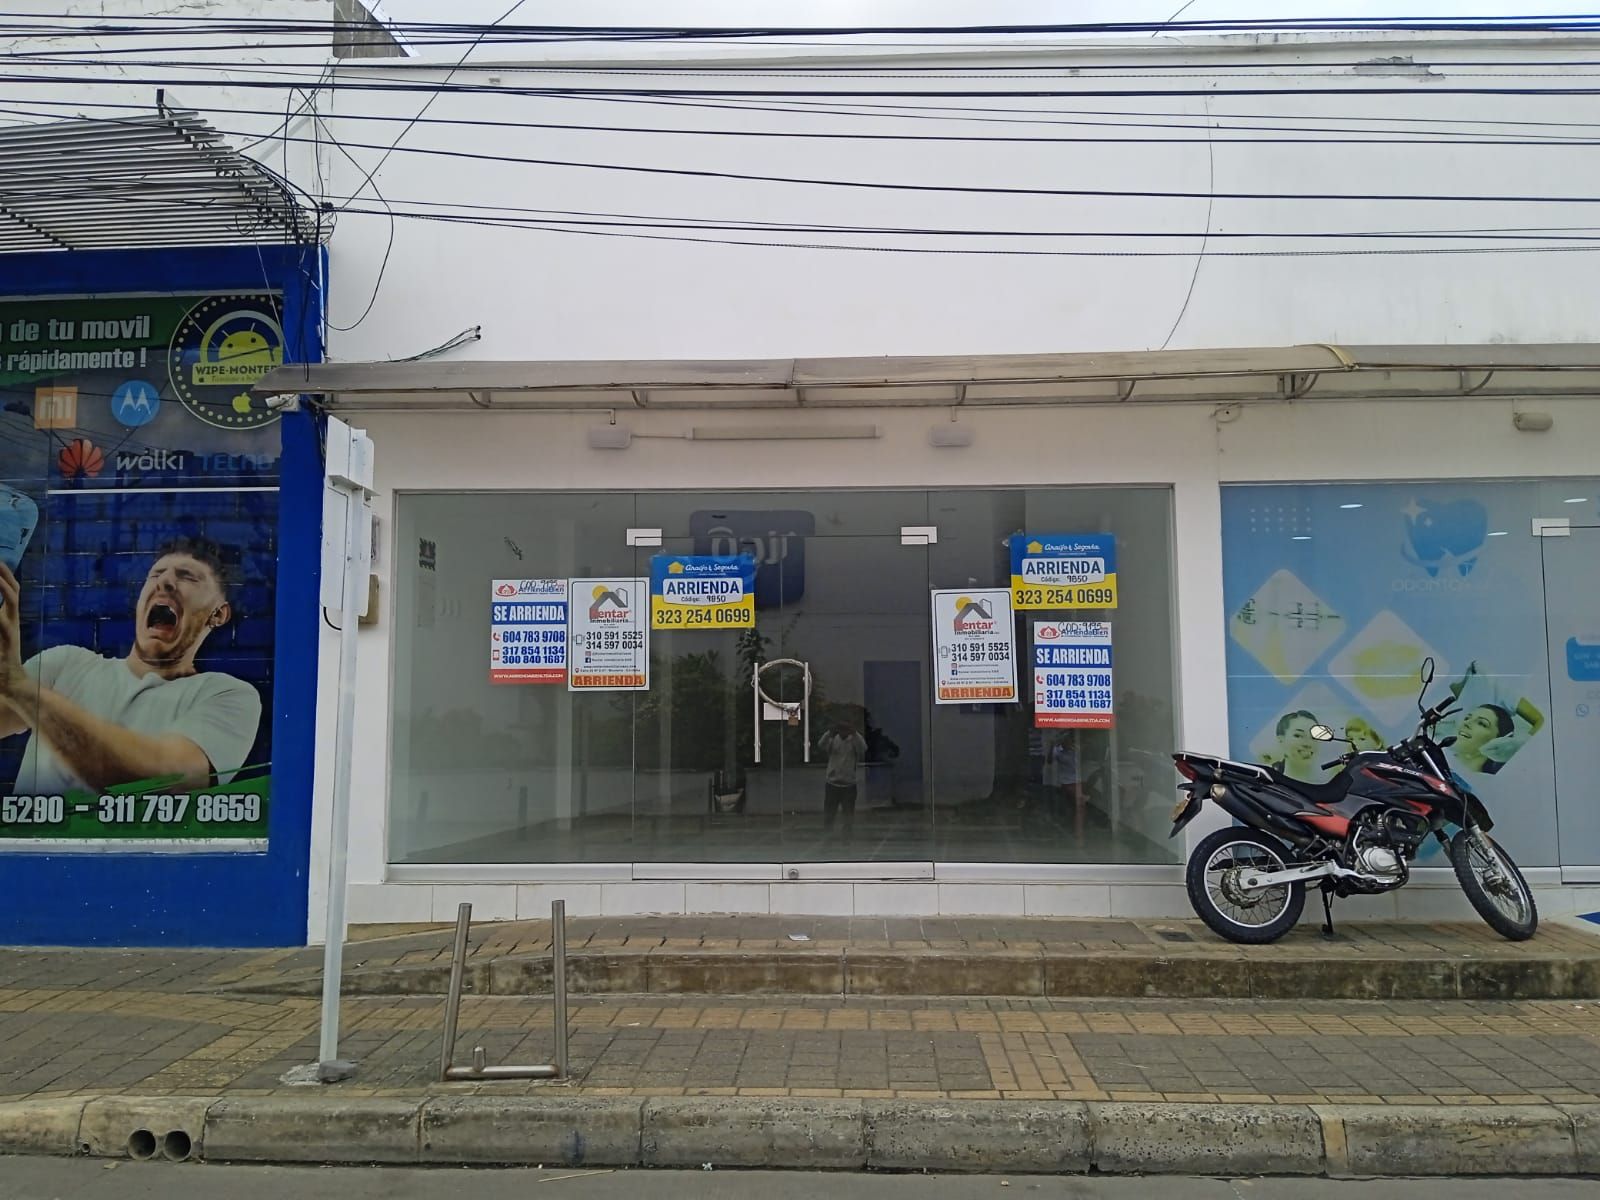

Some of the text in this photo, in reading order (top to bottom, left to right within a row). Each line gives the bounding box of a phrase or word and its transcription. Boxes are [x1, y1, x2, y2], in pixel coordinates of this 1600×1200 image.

[10, 319, 40, 342] de
[48, 318, 74, 341] tu
[81, 315, 151, 341] movil
[7, 348, 134, 373] rápidamente
[1025, 561, 1101, 575] ARRIENDA
[666, 581, 740, 595] ARRIENDA
[1016, 589, 1113, 604] 323 254 0699
[494, 605, 565, 621] SE ARRIENDA
[657, 609, 750, 624] 323 254 0699
[503, 631, 565, 643] 604 783 9708
[586, 631, 643, 640] 310 591 5525
[503, 646, 565, 656] 317 854 1134
[586, 641, 643, 649] 314 597 0034
[951, 642, 1009, 652] 310 591 5525
[502, 655, 565, 664] 300 840 1687
[951, 652, 1009, 662] 314 597 0034
[1036, 649, 1109, 665] SE ARRIENDA
[574, 676, 643, 686] ARRIENDA
[1047, 674, 1110, 687] 604 783 9708
[942, 688, 1011, 698] ARRIENDA
[1047, 690, 1110, 699] 317 854 1134
[1047, 699, 1110, 708] 300 840 1687
[2, 796, 63, 823] 5290
[98, 795, 135, 823] 311
[141, 795, 190, 822] 797
[196, 795, 260, 822] 8659
